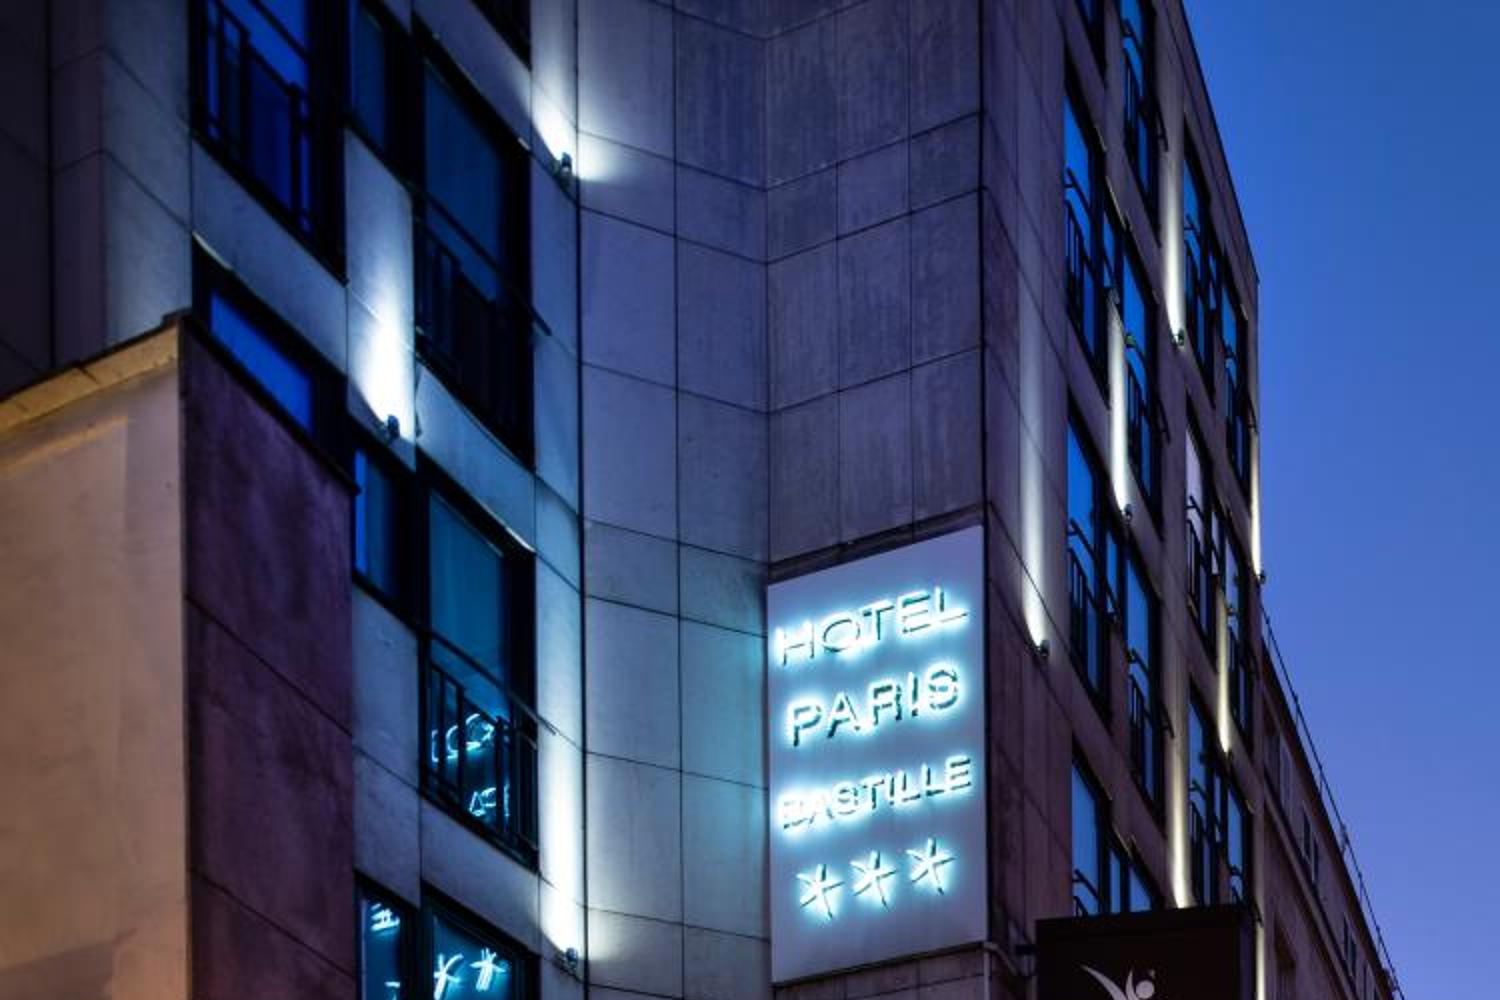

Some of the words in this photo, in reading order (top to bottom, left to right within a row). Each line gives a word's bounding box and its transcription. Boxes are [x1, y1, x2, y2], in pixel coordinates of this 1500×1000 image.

[774, 586, 969, 667] HOTEL
[786, 663, 961, 747] PARIS
[778, 754, 973, 831] BASTILLE
